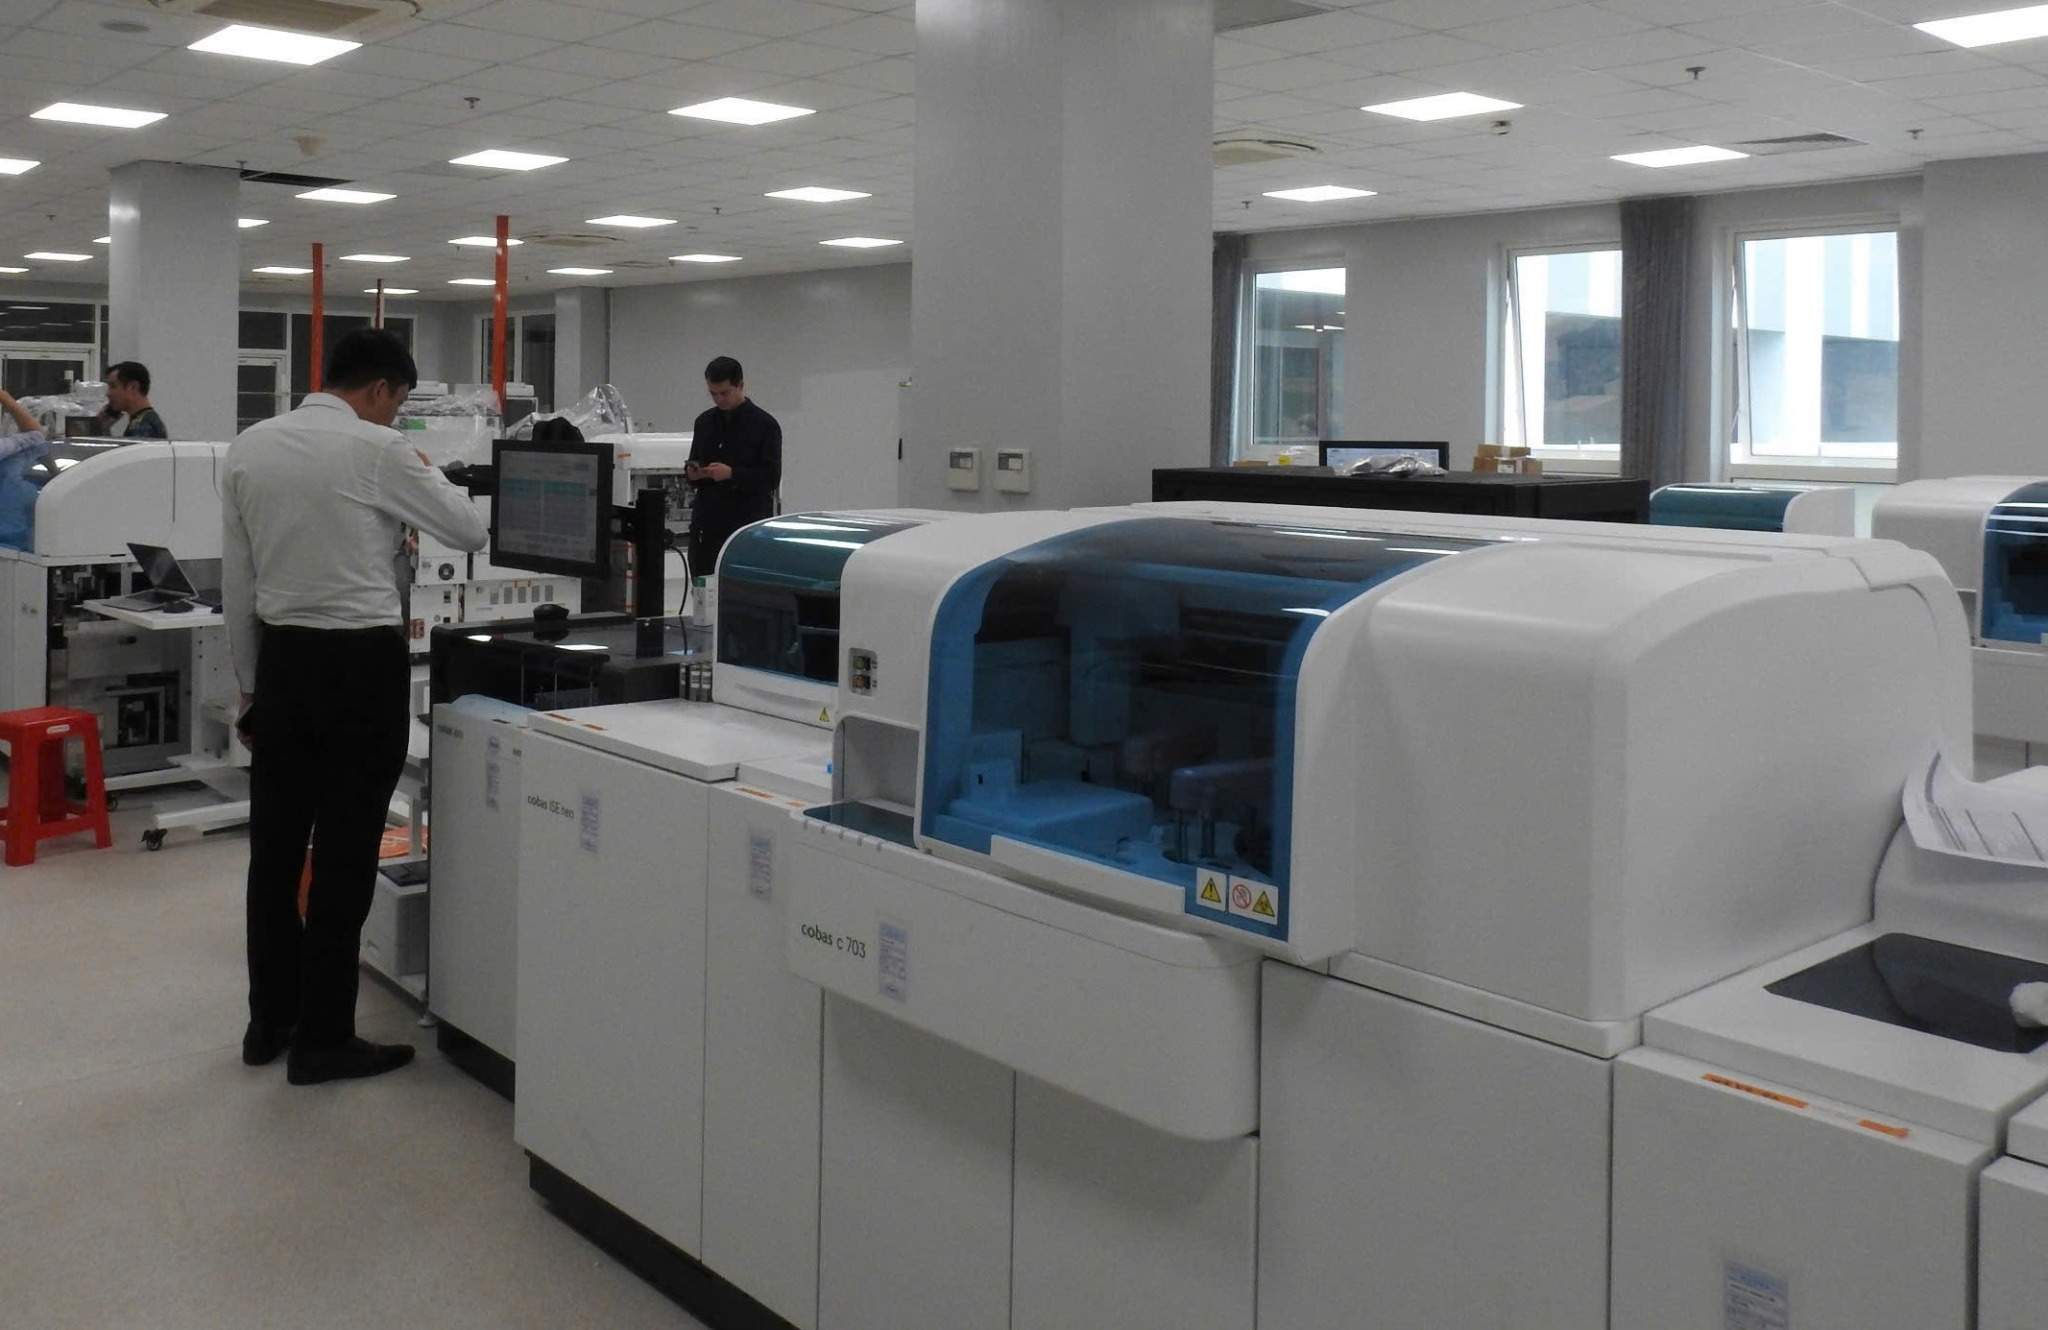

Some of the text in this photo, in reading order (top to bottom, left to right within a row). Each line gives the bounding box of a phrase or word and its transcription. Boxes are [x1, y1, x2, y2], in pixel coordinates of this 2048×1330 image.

[528, 795, 548, 809] cobas
[801, 924, 866, 958] cobas c 703
